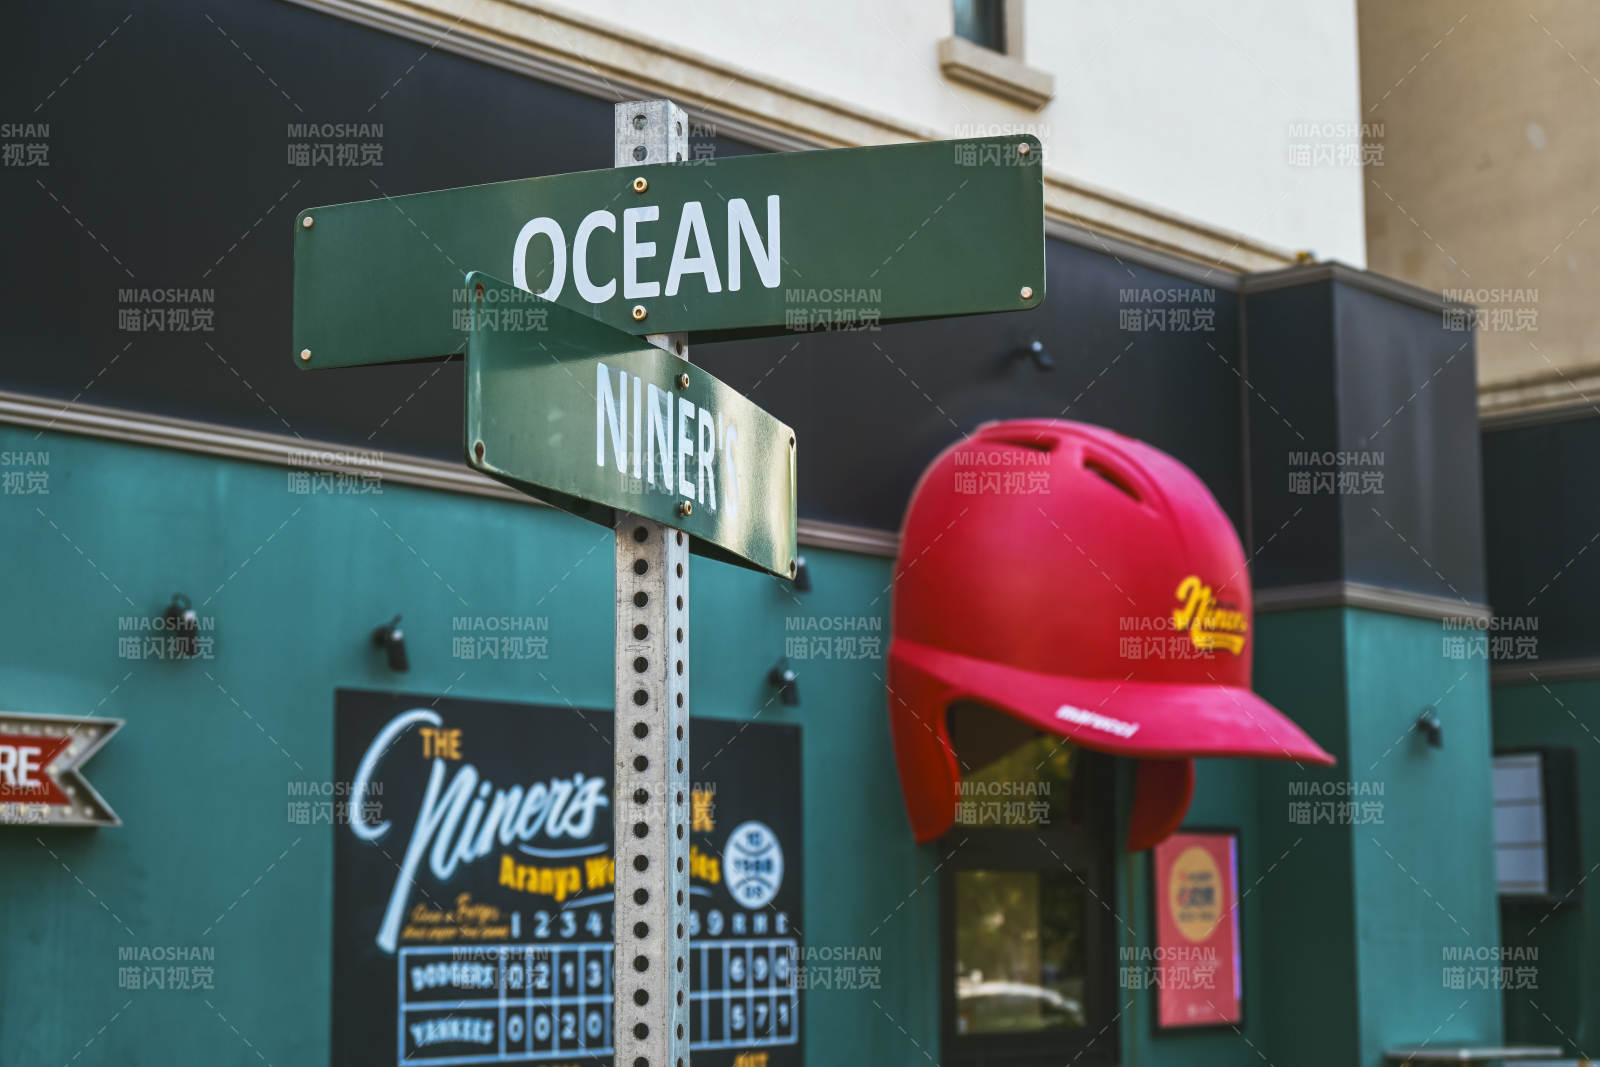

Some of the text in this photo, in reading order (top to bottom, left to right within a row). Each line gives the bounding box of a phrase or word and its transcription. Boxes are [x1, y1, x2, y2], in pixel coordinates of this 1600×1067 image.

[512, 194, 781, 304] OCEAN
[596, 362, 739, 519] NINER'S
[419, 727, 463, 760] THE
[499, 854, 582, 902] Aranya
[511, 911, 521, 938] 1
[534, 910, 551, 938] 2
[560, 910, 577, 938] 3
[585, 910, 603, 937] 4
[707, 909, 724, 936] 9
[587, 960, 602, 988] 3
[410, 1017, 494, 1047] YANKEES
[507, 1015, 524, 1042] 0
[534, 1013, 551, 1041] 0
[561, 1012, 576, 1040] 2
[587, 1011, 601, 1038] 0
[755, 1003, 768, 1028] 7
